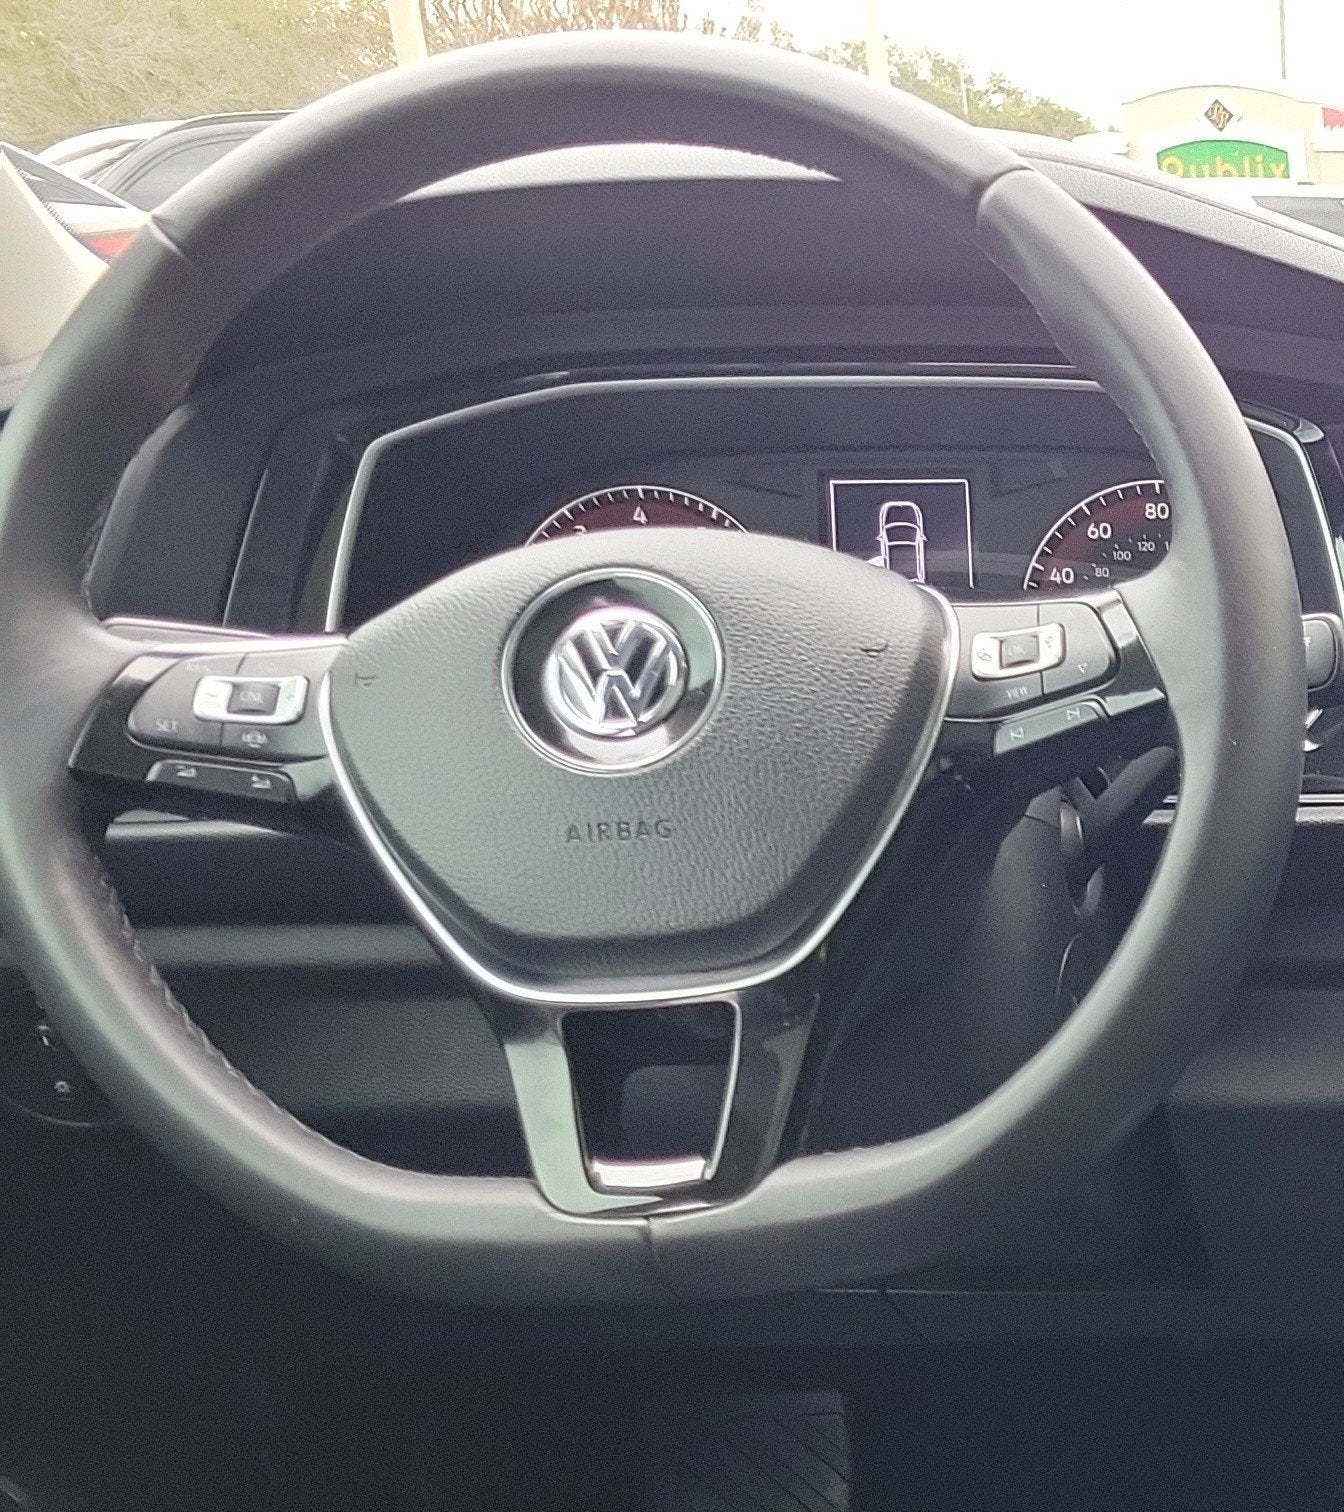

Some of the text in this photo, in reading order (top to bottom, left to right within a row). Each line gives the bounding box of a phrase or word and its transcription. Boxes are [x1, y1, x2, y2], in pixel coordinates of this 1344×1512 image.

[632, 506, 648, 525] 4
[1144, 502, 1170, 520] 80
[1087, 522, 1112, 540] 60
[1137, 541, 1156, 552] 120
[1112, 550, 1132, 561] 100
[1049, 567, 1075, 584] 40
[1094, 567, 1110, 578] 80
[566, 819, 672, 842] AIRBAG
